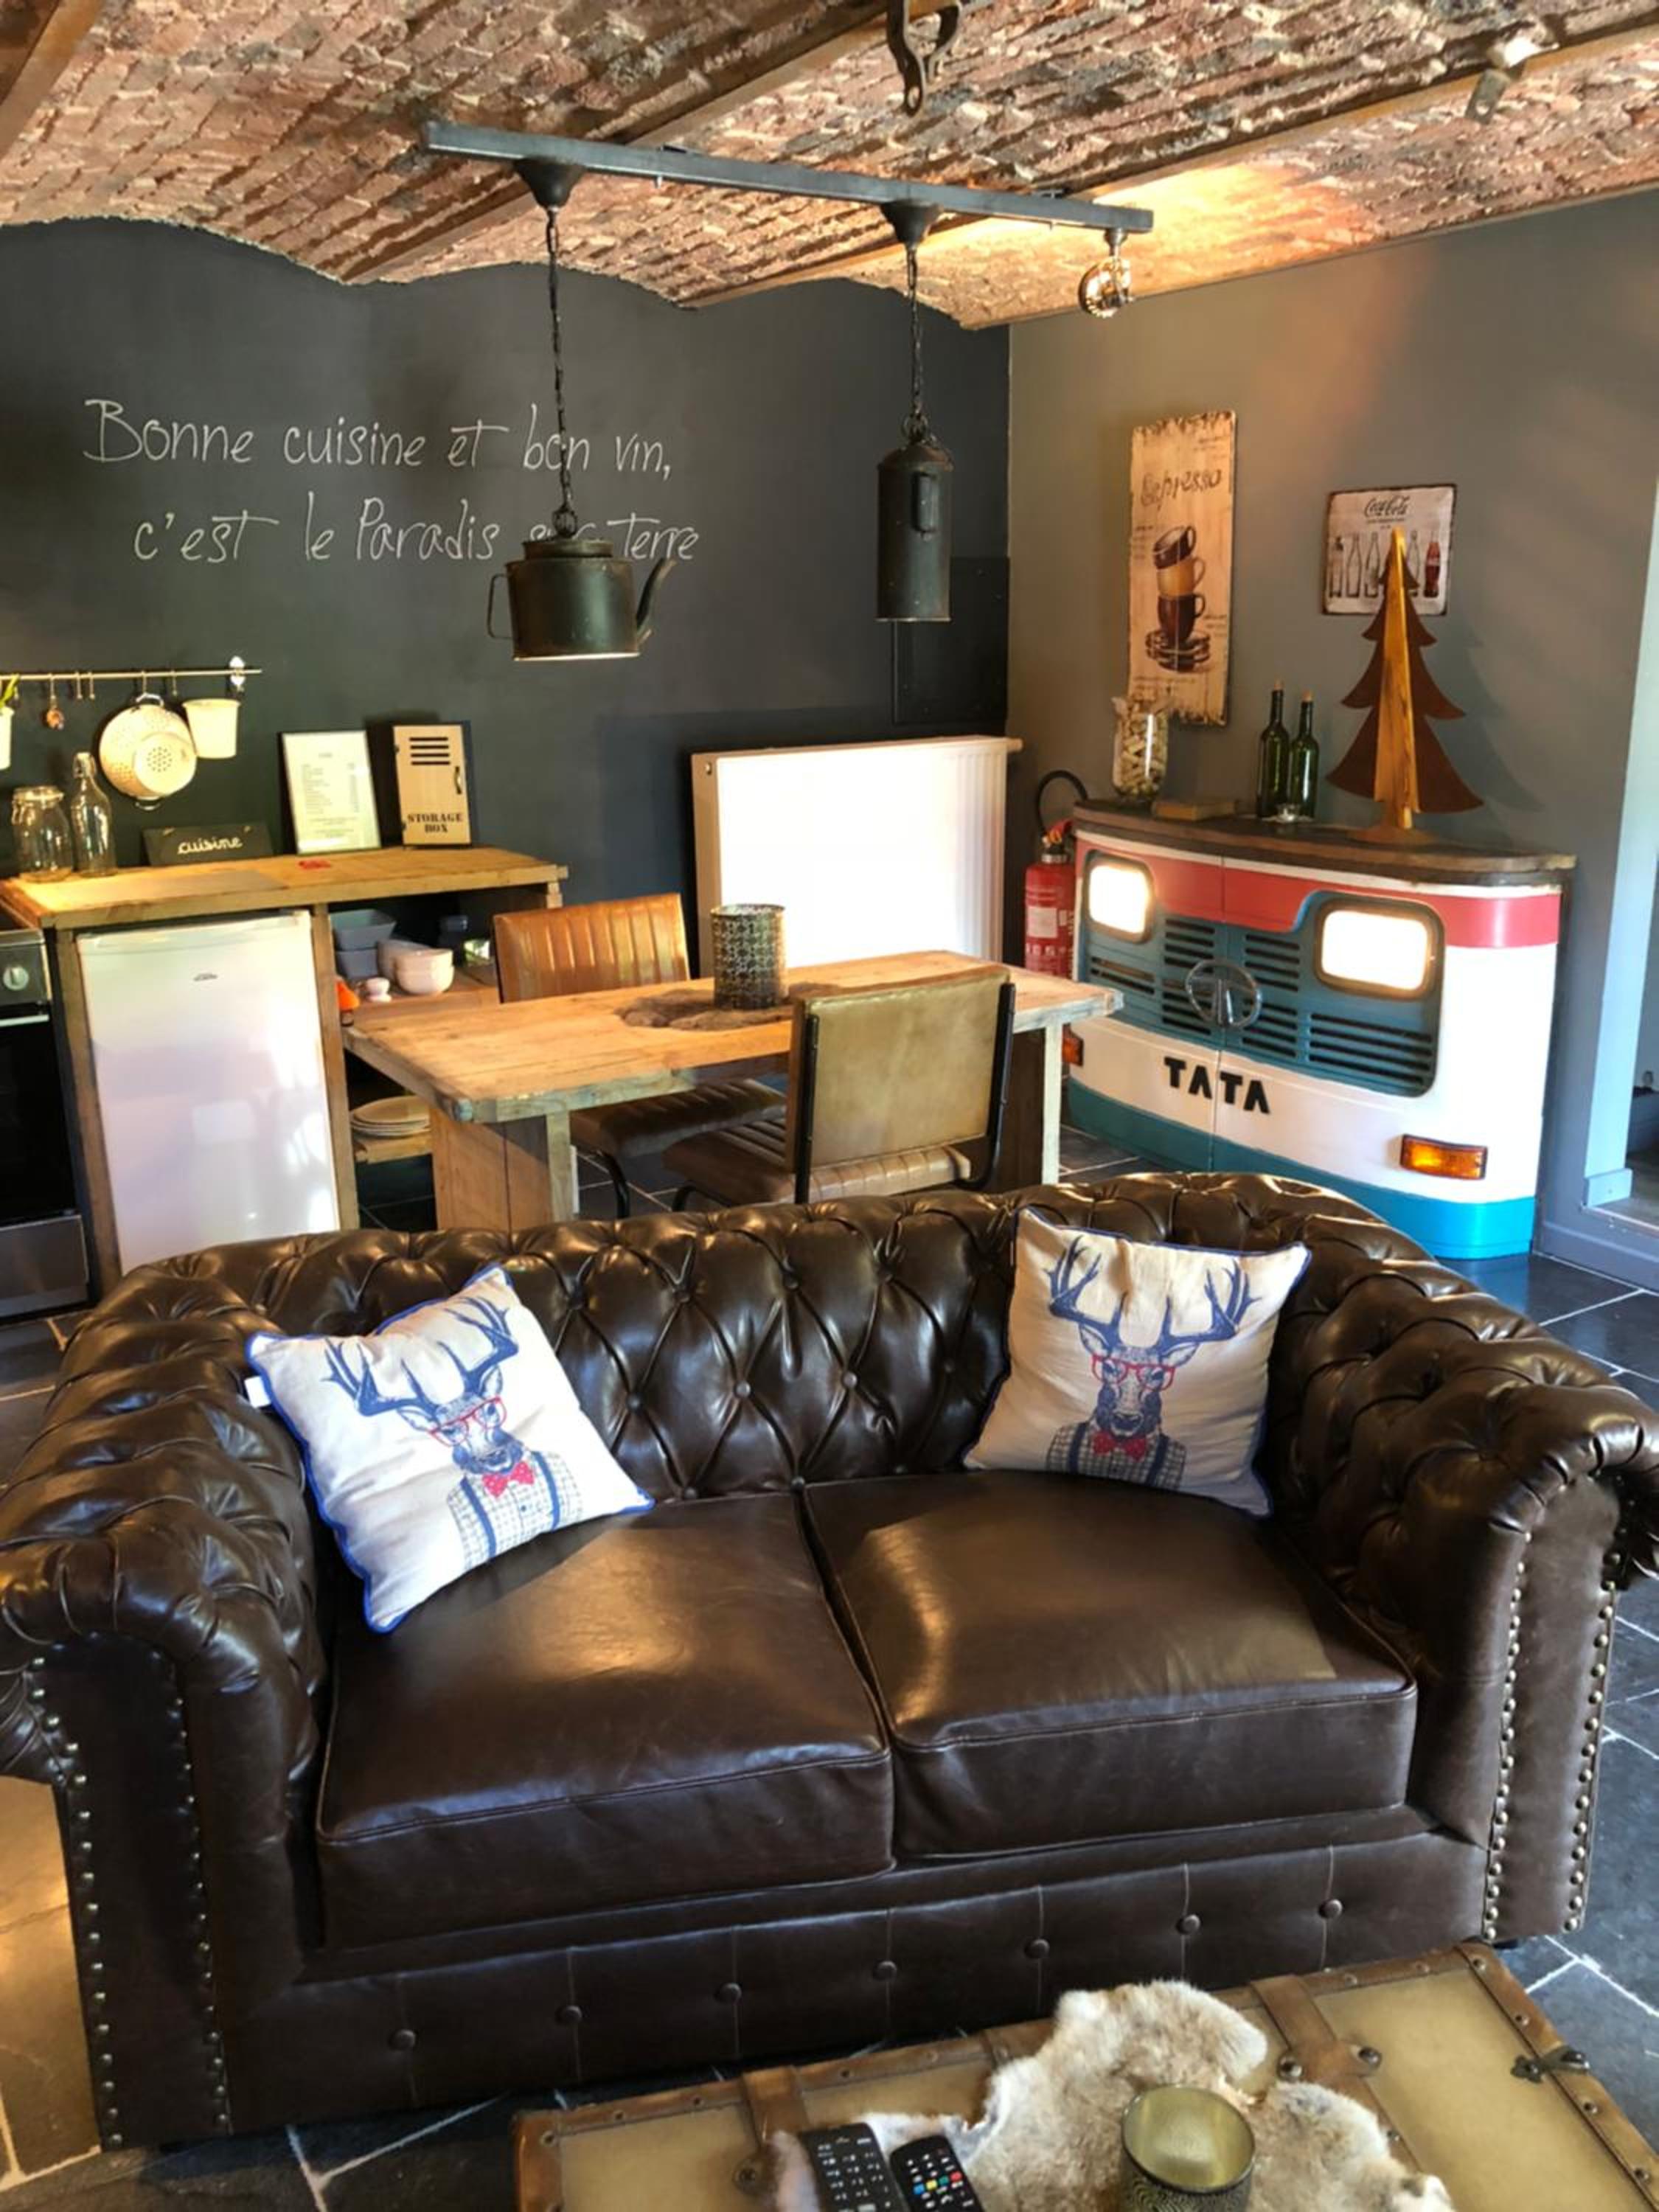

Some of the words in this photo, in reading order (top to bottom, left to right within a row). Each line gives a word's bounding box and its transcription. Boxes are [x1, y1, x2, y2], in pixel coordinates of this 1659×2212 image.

[83, 399, 254, 463] Bonne
[284, 416, 426, 466] cuisine
[451, 419, 510, 467] et
[523, 403, 590, 470] bon
[615, 433, 672, 481] vin,
[133, 509, 280, 563] c'est
[305, 490, 335, 561] le
[355, 497, 501, 561] Paradis
[606, 512, 700, 560] terre
[407, 813, 463, 824] STORAGE
[424, 823, 448, 834] BOX
[177, 835, 243, 855] cuisine
[1163, 1056, 1271, 1115] TATA
